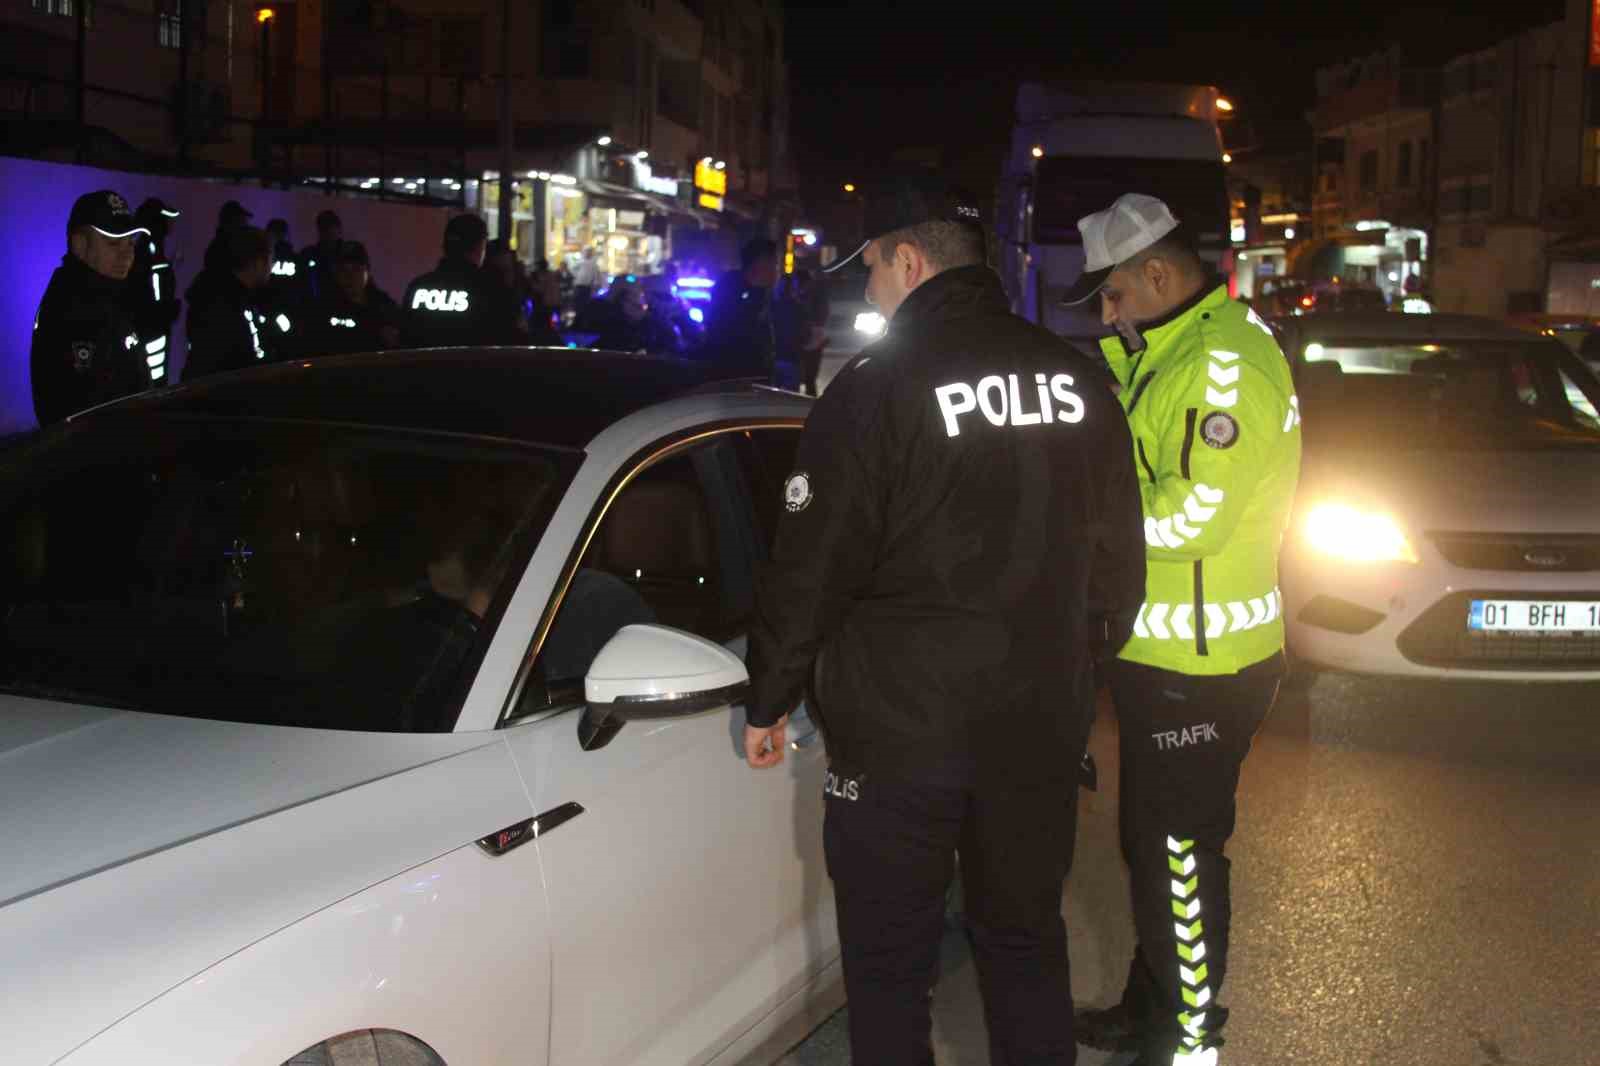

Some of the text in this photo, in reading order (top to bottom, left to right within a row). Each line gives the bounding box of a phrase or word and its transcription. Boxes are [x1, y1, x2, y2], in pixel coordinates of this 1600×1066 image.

[1485, 604, 1600, 626] 01 BFH 1
